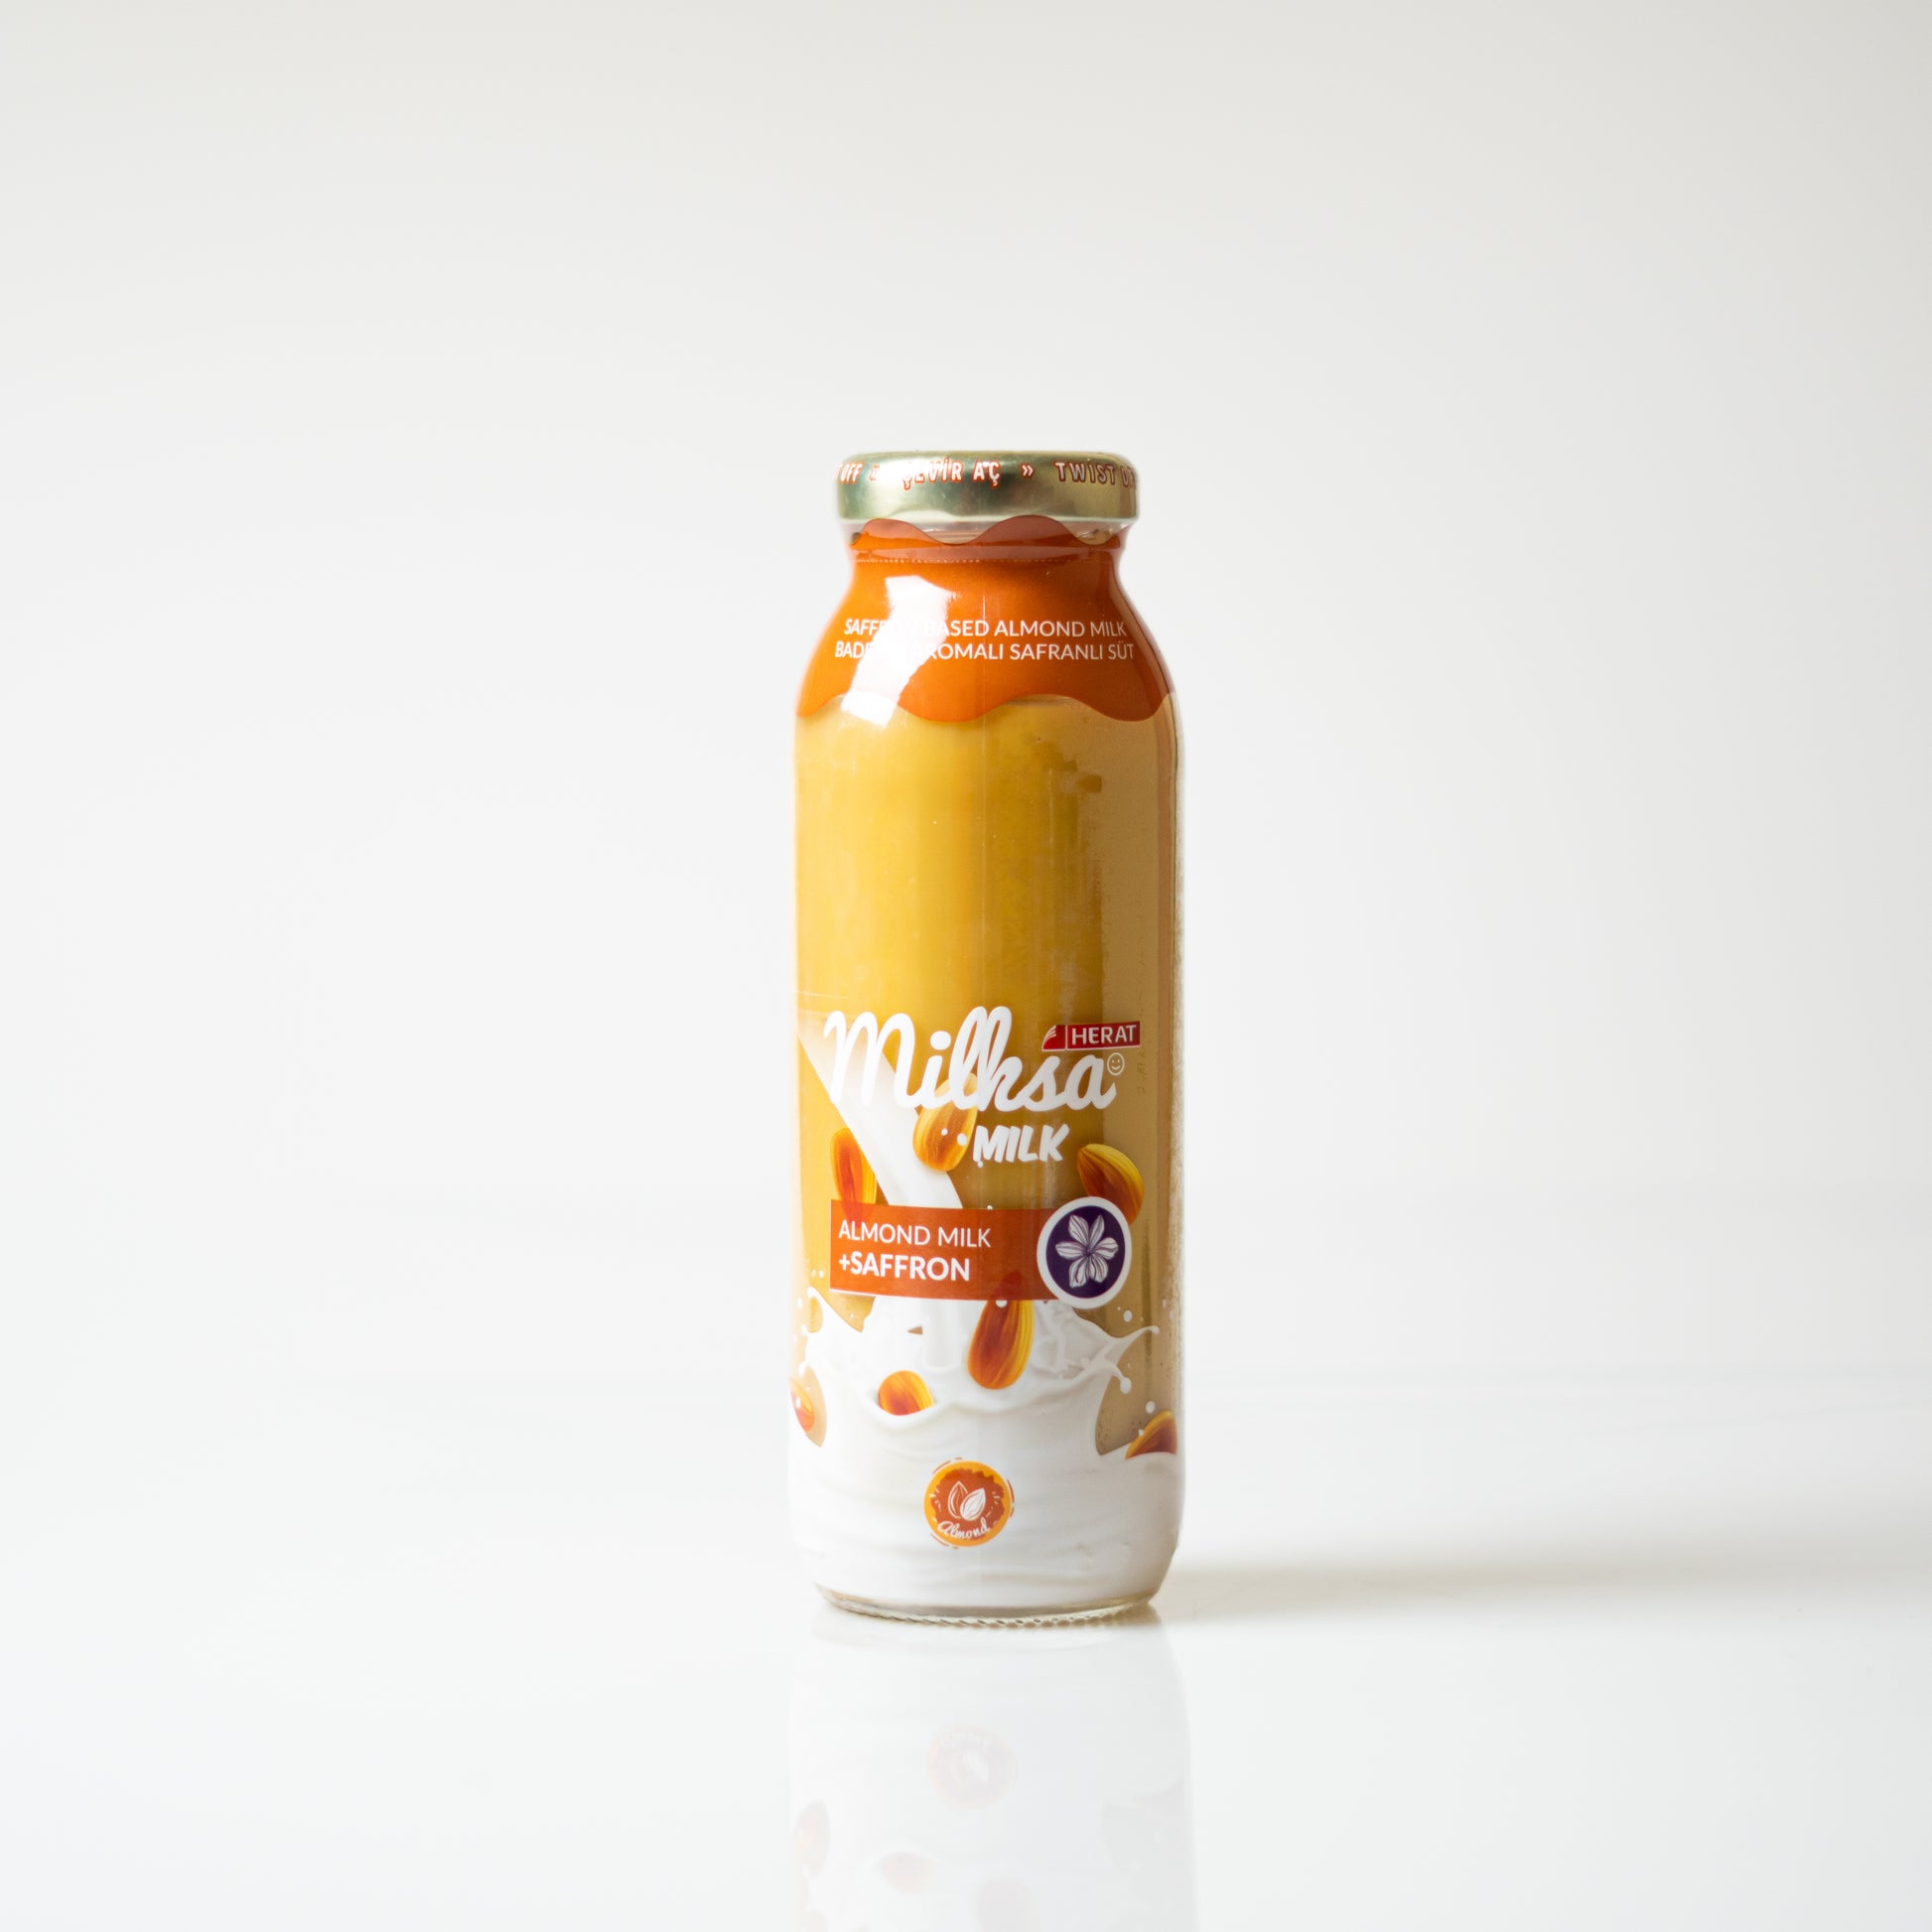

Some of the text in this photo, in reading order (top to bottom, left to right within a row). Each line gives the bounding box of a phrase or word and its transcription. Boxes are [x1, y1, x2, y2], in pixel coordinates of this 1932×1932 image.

[840, 462, 864, 484] OFF
[972, 461, 1001, 489] AÇ
[1053, 461, 1115, 485] TWIST
[929, 620, 990, 636] ASED
[994, 621, 1086, 637] ALMOND
[1090, 621, 1128, 637] MILK
[1009, 642, 1103, 661] SAFRANLI
[1107, 640, 1135, 660] SÜT
[1071, 1025, 1137, 1046] HERAT
[822, 1005, 1117, 1112] Milksa
[972, 1123, 1070, 1165] MILK
[838, 1219, 992, 1248] ALMOND MILK
[838, 1249, 971, 1283] +SAFFRON
[936, 1516, 991, 1540] Almond
